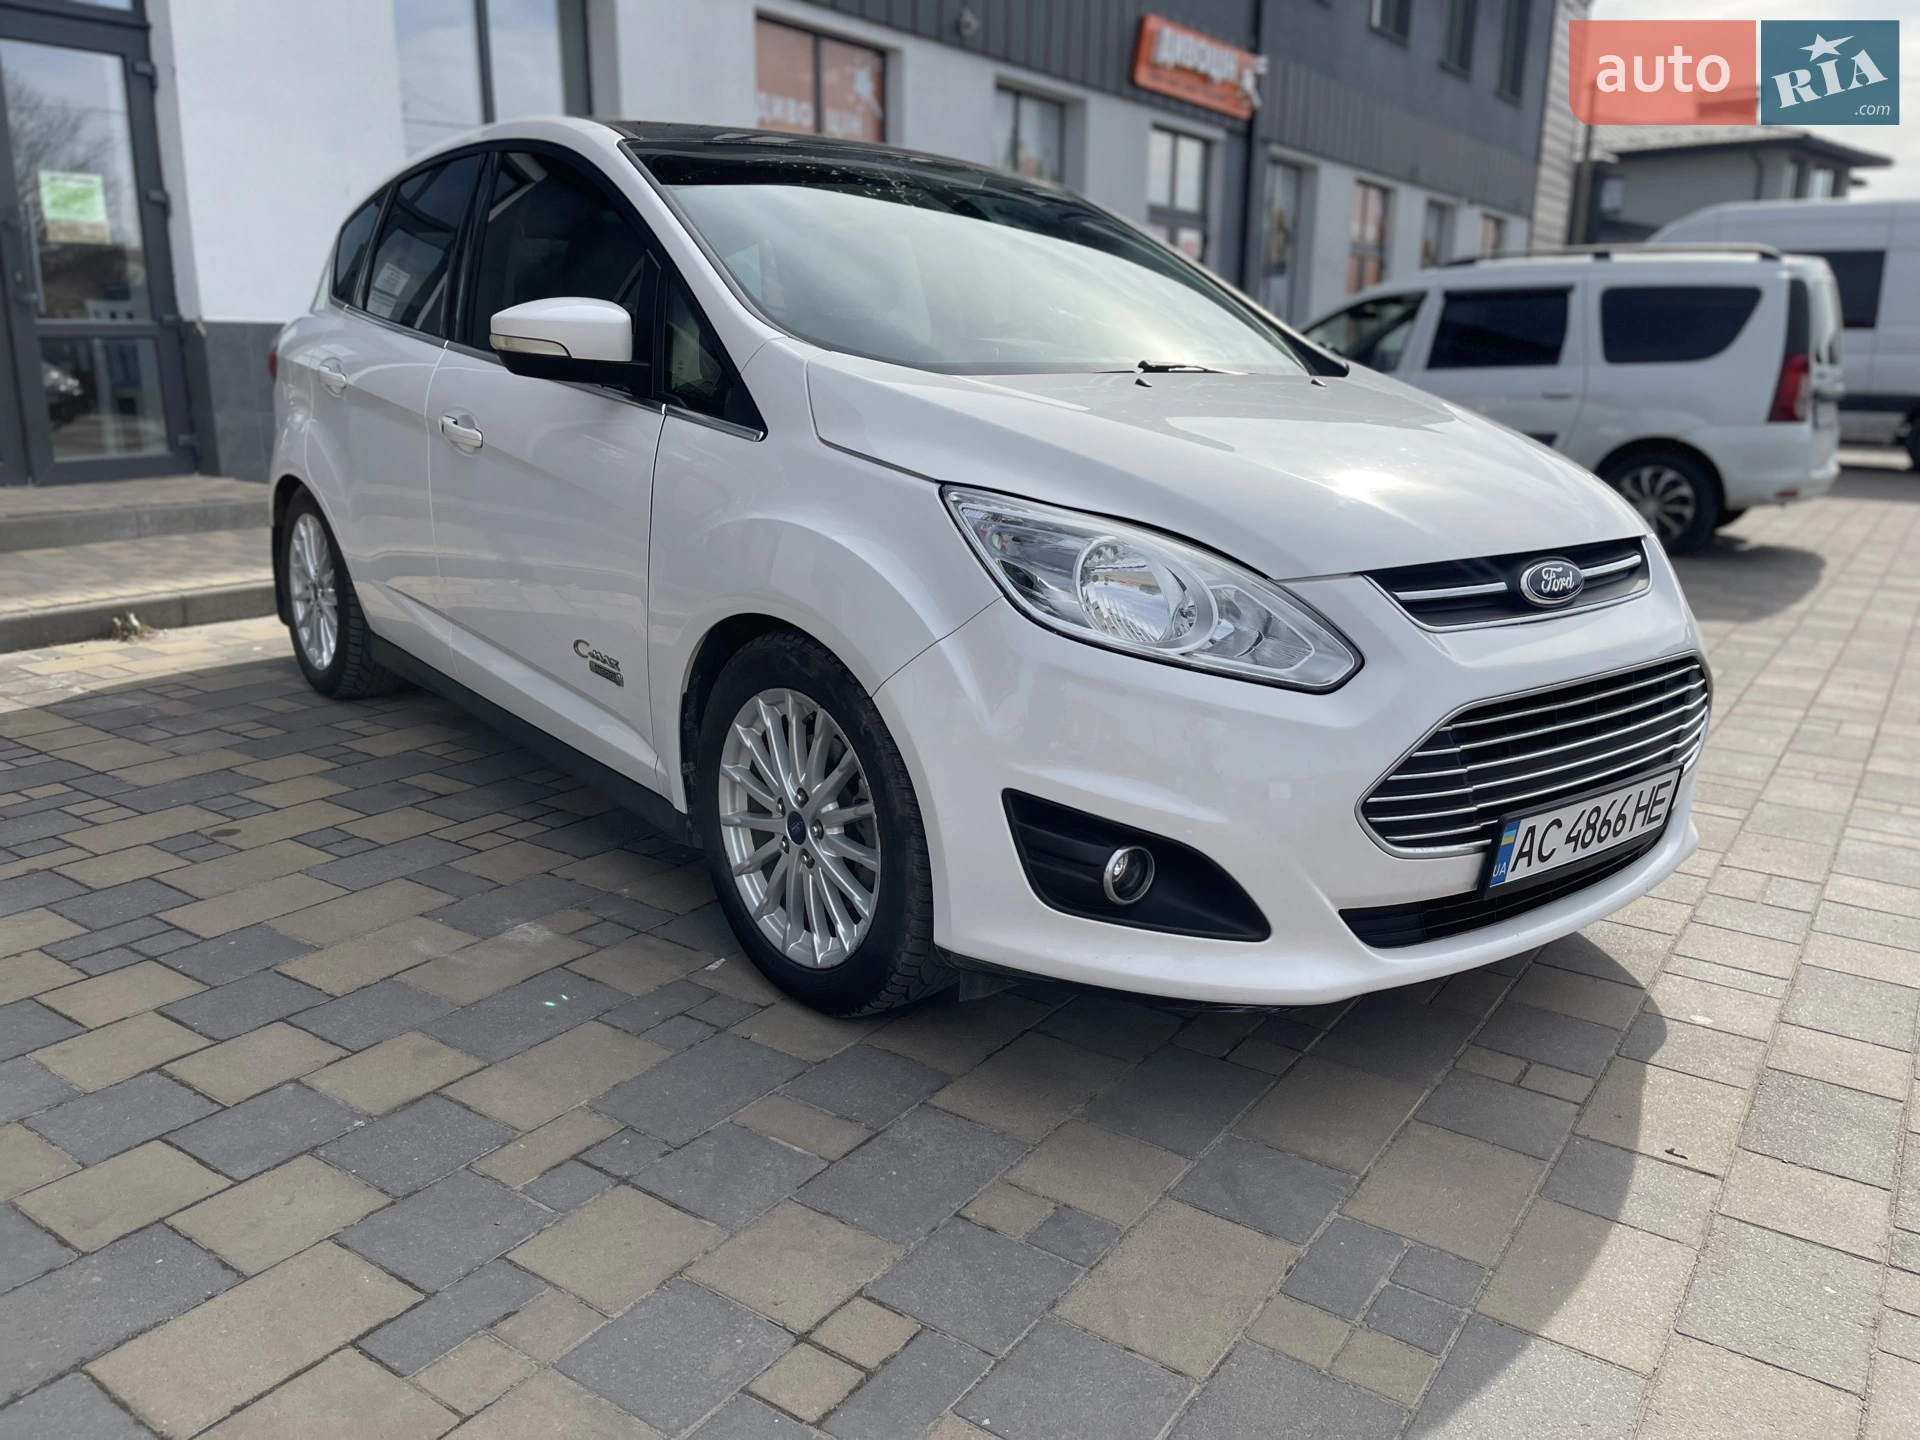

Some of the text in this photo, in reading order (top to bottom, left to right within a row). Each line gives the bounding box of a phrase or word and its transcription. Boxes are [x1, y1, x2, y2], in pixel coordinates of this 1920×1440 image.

[1541, 567, 1575, 593] Ford
[1510, 780, 1673, 873] AC 4866 HE
[1492, 861, 1507, 878] UA
